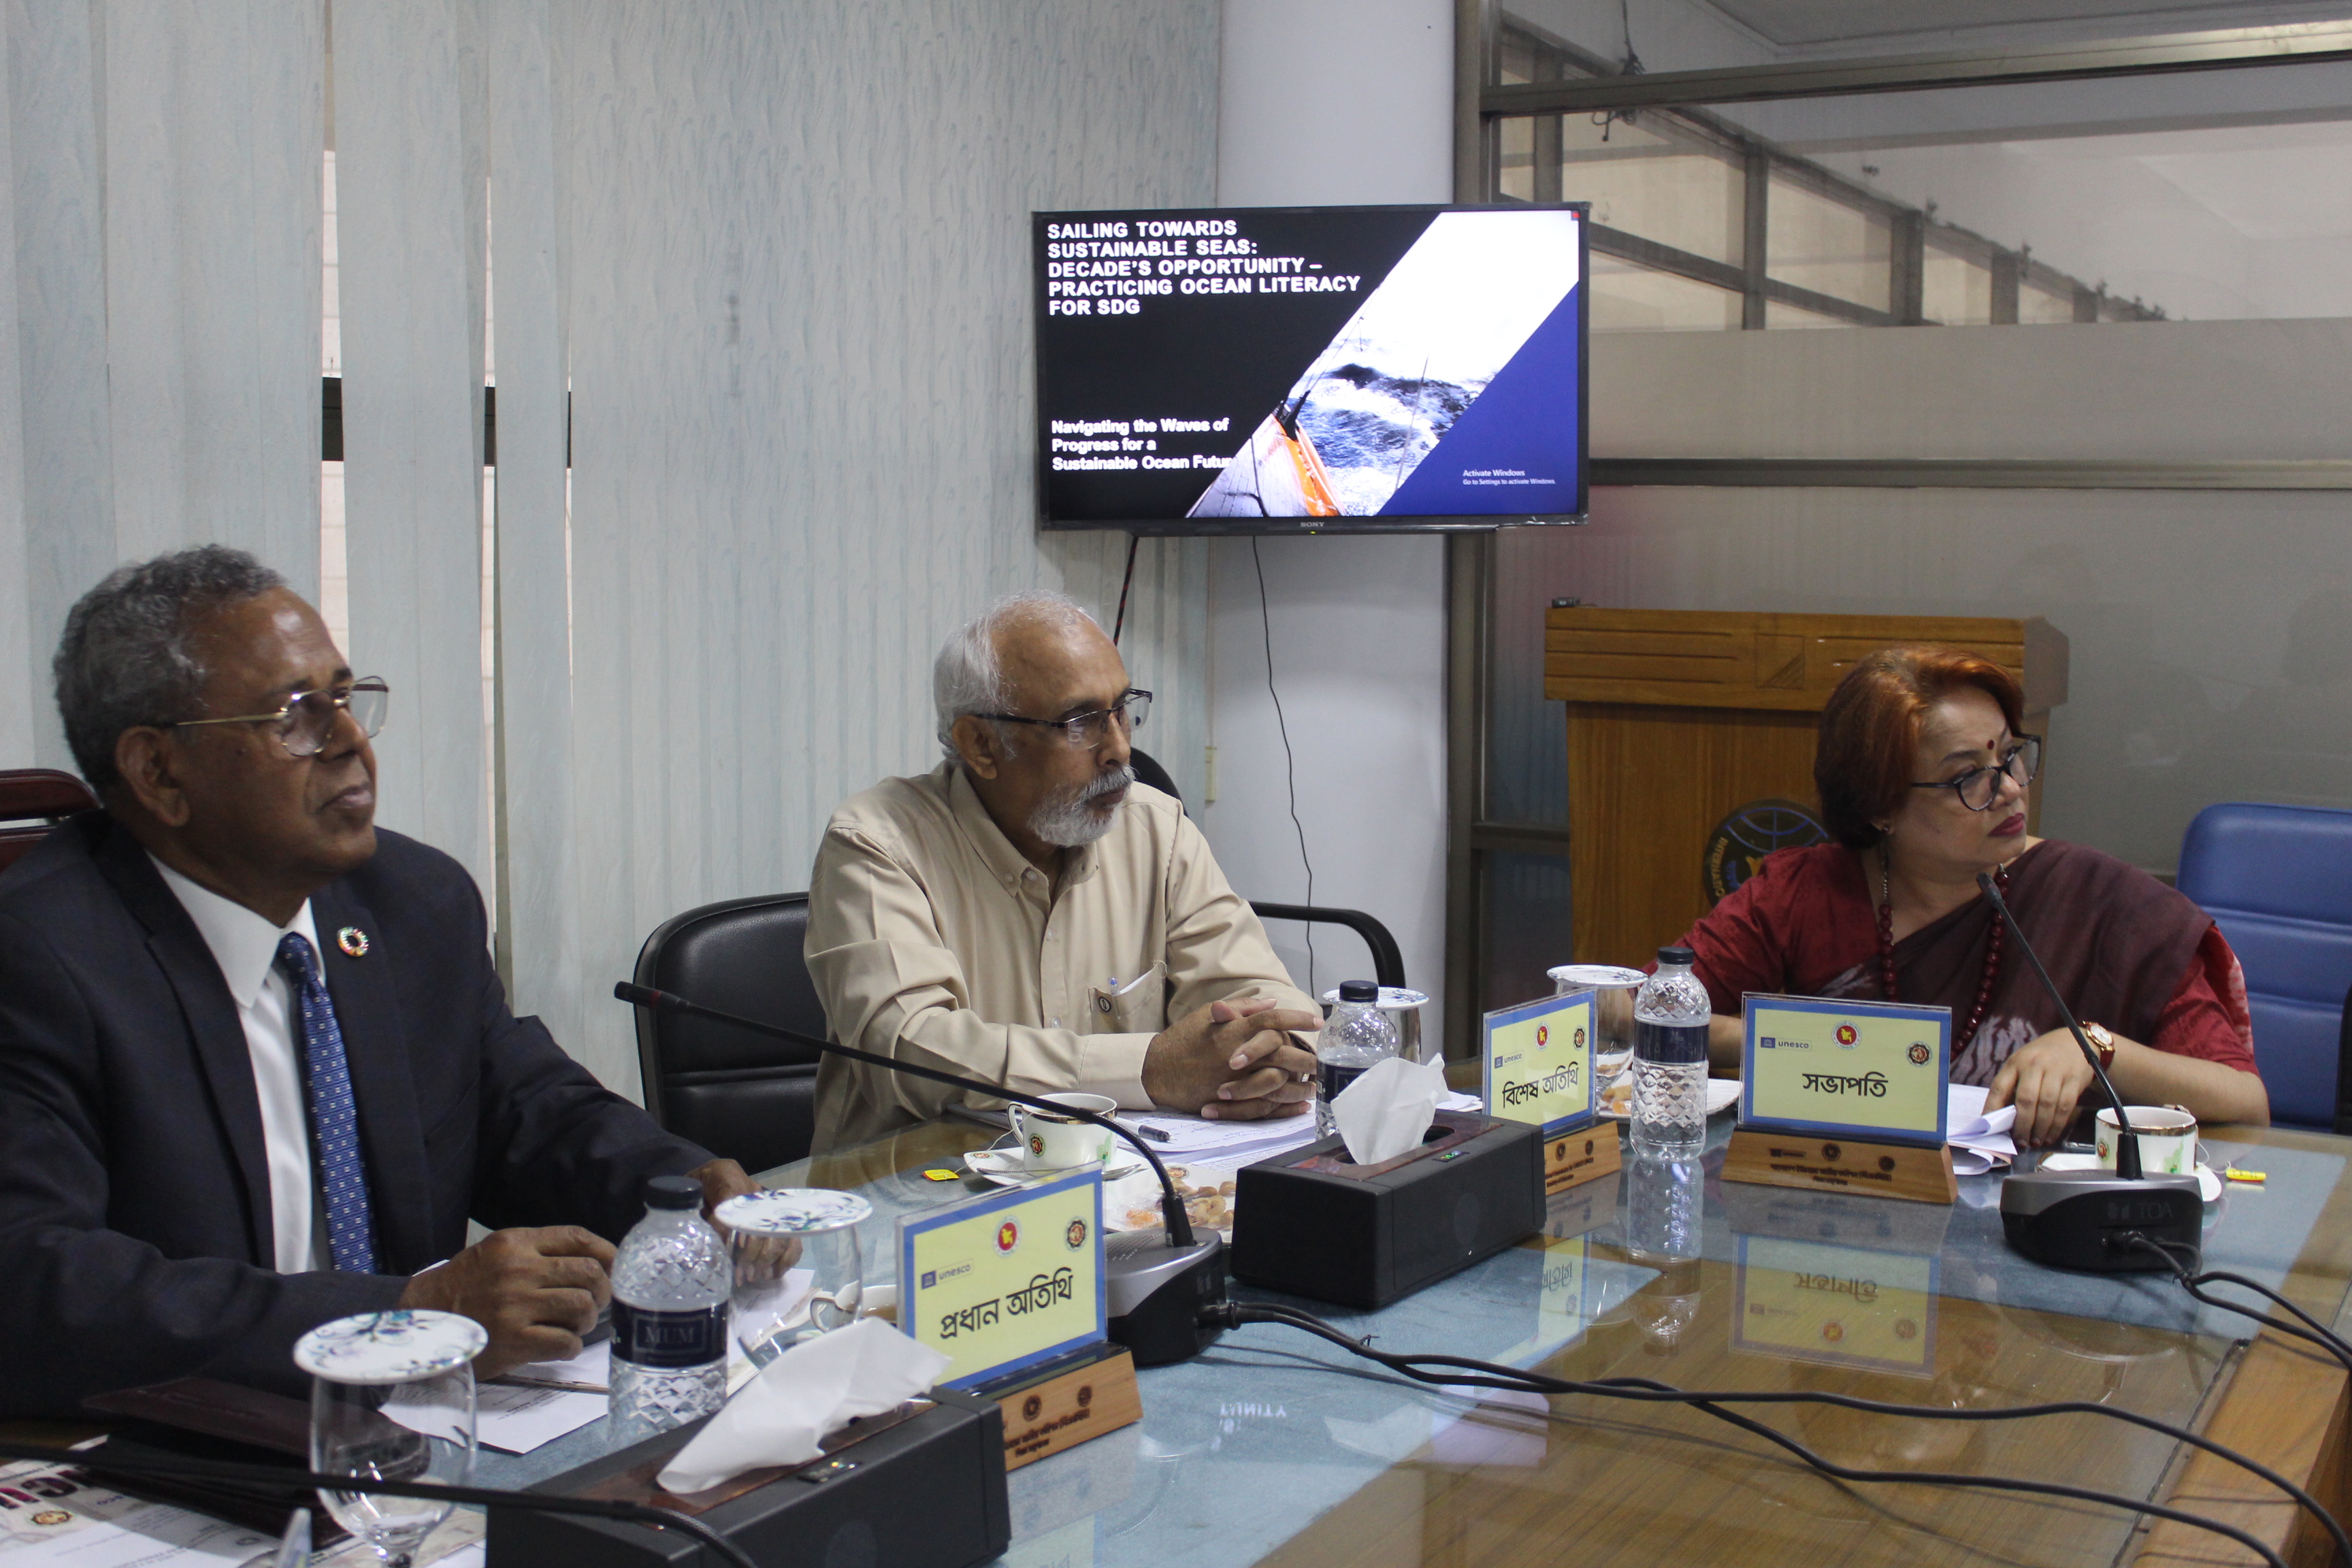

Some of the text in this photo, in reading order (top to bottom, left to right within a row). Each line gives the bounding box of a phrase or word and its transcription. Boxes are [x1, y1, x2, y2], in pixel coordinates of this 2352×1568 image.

[1047, 220, 1237, 239] SAILING TOWARDS
[1048, 239, 1258, 258] SUSTAINABLE SEAS:
[1049, 260, 1152, 278] DECADE’S
[1158, 257, 1305, 276] OPPORTUNITY
[1049, 276, 1361, 297] PRACTICING OCEAN LITERACY
[1049, 299, 1140, 316] FOR SDG
[1051, 417, 1230, 436] Navigating the Waves of
[1051, 438, 1156, 455] Progress for a
[1052, 455, 1232, 470] Sustainable Ocean Futur
[1778, 1040, 1809, 1049] unesco
[1504, 1053, 1522, 1063] unesco
[1502, 1061, 1579, 1109] বিশেষ অতিথি
[1802, 1071, 1889, 1098] সভাপতি
[939, 1264, 970, 1279] unesco
[941, 1267, 1073, 1339] প্রধান অতিথি
